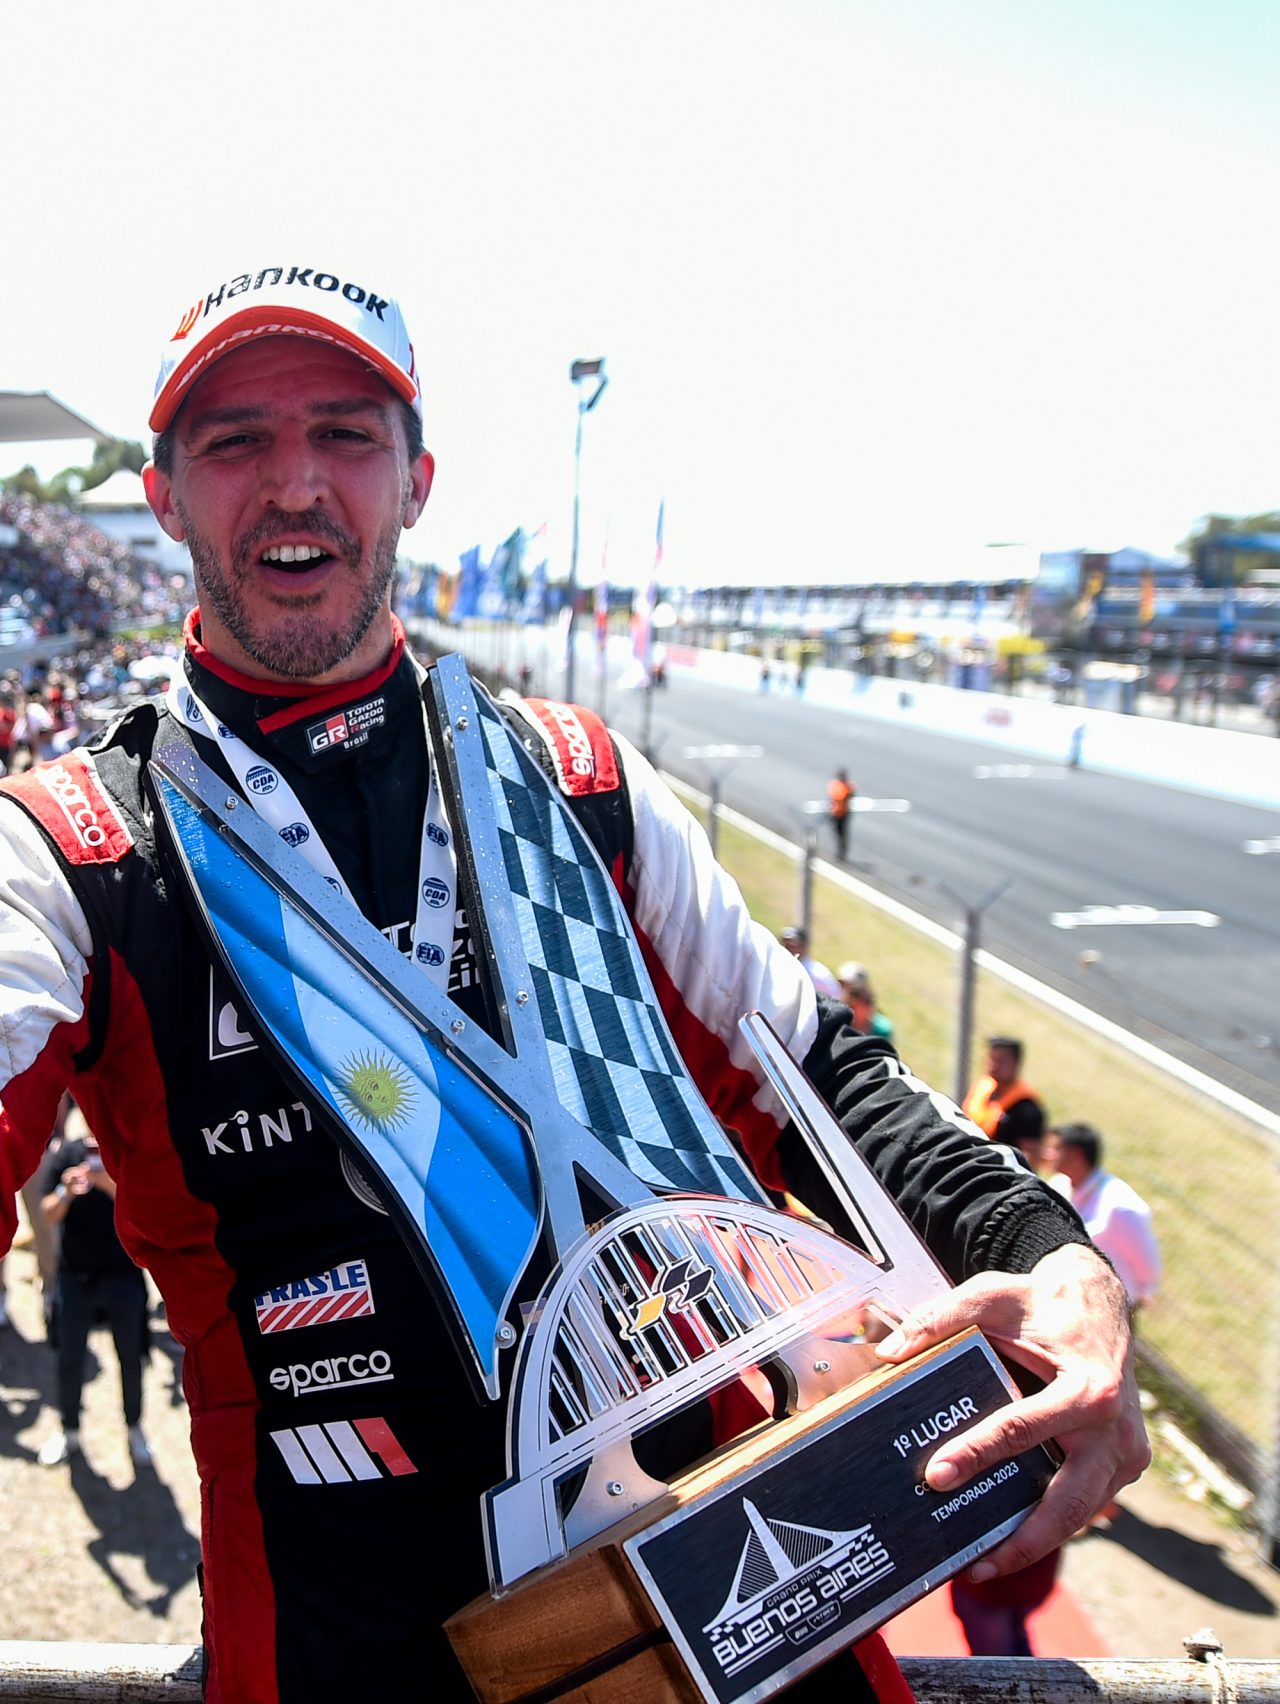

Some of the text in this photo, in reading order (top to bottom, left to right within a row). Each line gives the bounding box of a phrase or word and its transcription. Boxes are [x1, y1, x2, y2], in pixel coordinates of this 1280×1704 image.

[346, 697, 385, 719] TOYOTA
[348, 706, 384, 727] GAZOO
[350, 714, 385, 734] Racing
[312, 723, 347, 750] GR
[343, 731, 369, 750] Brasil
[252, 773, 275, 791] CDA
[427, 827, 447, 845] FIA
[425, 887, 447, 902] CDA
[419, 945, 442, 963] FIA
[269, 1350, 394, 1398] sparco
[910, 1396, 980, 1448] LUGAR
[931, 1461, 1020, 1524] TEMPORADA 2023
[799, 1567, 823, 1585] PRIX
